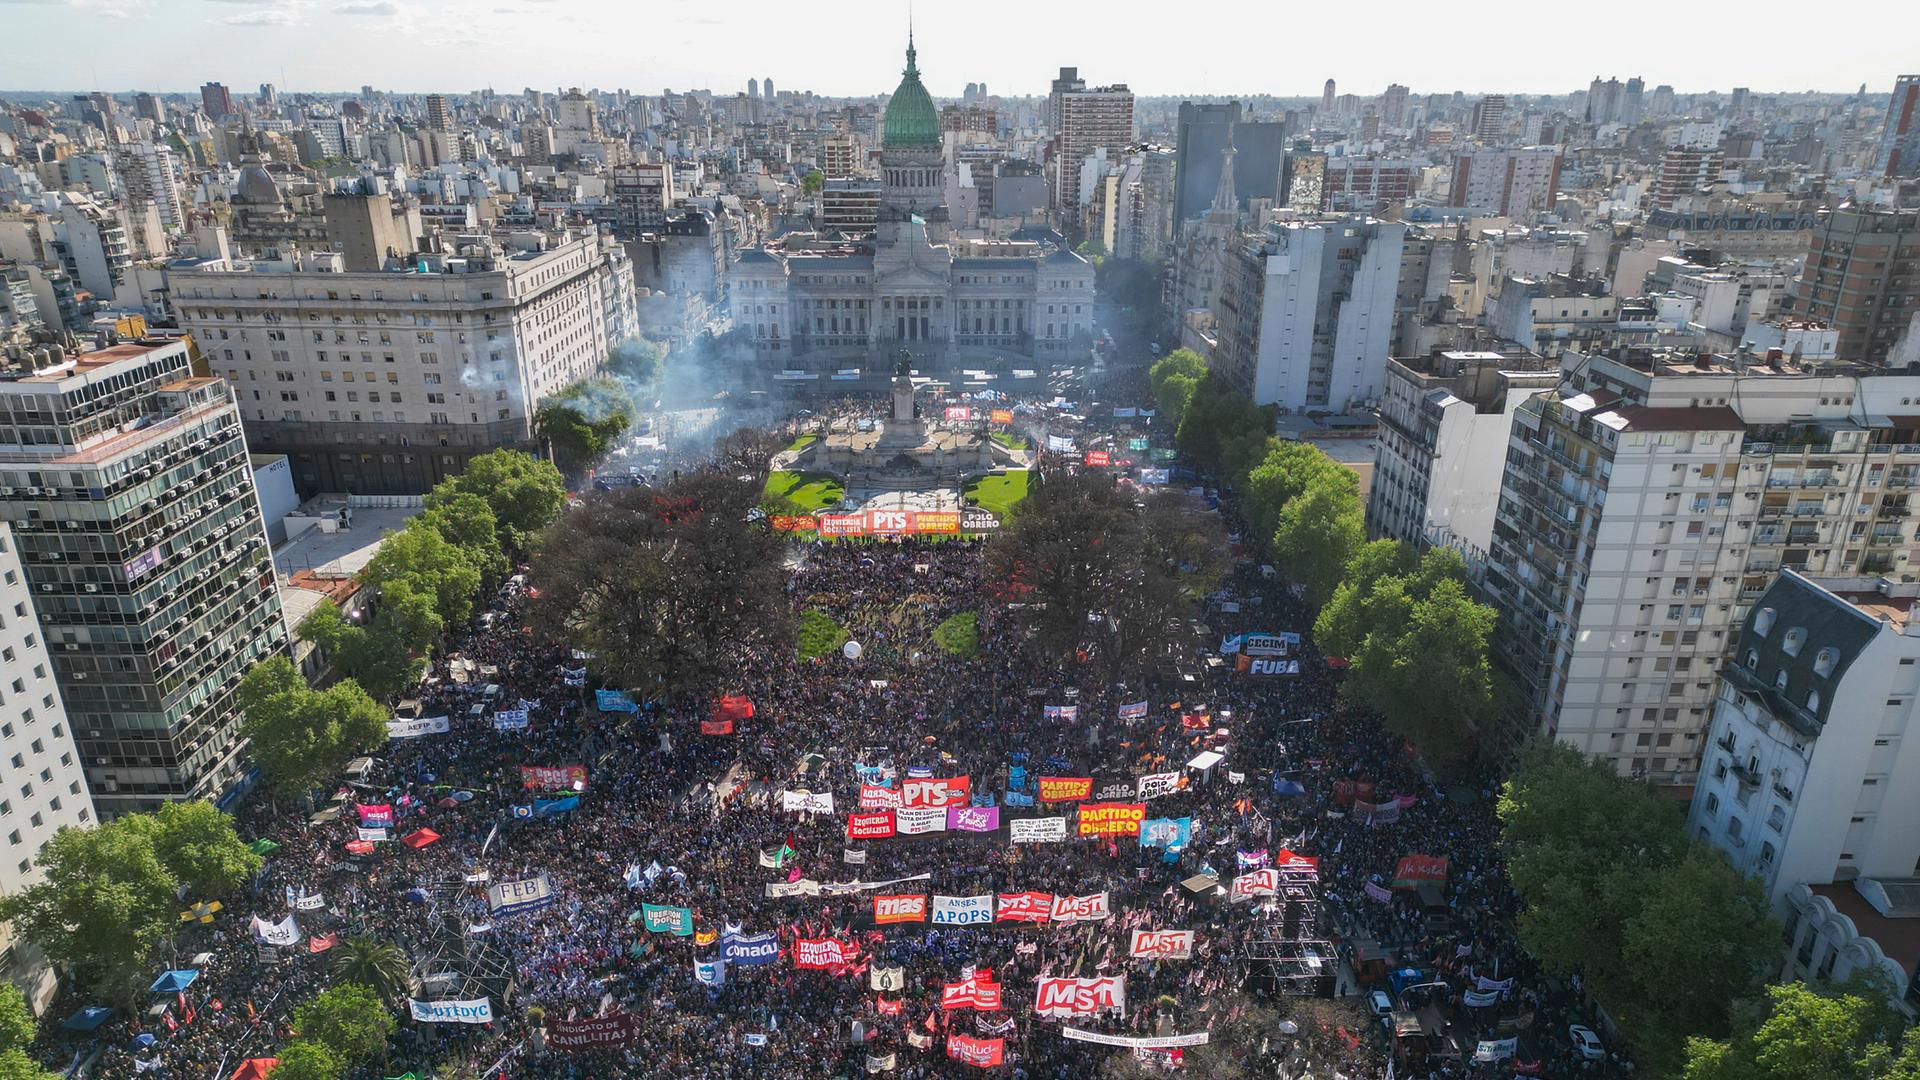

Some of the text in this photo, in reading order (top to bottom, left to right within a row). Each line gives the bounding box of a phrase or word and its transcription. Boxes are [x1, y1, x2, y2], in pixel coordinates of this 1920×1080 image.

[269, 460, 286, 472] HOTEL
[873, 511, 907, 529] PTS
[916, 514, 957, 523] PARTIDO
[962, 519, 1000, 529] OBRERO
[968, 513, 993, 522] POLO
[918, 522, 956, 531] OBRERO
[1248, 638, 1286, 648] CECIM
[1250, 660, 1300, 674] FUBA
[1041, 781, 1089, 790] PARTIDO
[1102, 784, 1129, 792] POLO
[903, 781, 948, 805] PTS
[1042, 788, 1087, 799] OBRERO
[1095, 789, 1135, 800] OBRERO
[854, 816, 889, 826] IZQUIERDA
[1080, 808, 1143, 821] PARTIDO
[853, 826, 890, 835] SOCIALISTA
[1080, 820, 1138, 833] OBRERO
[501, 880, 537, 899] FEB
[880, 897, 924, 914] mas
[948, 899, 977, 907] ANSES
[1060, 897, 1102, 916] MST
[935, 910, 990, 923] APOPS
[1138, 933, 1186, 952] MST
[726, 942, 778, 957] conadu
[945, 980, 976, 998] PTS
[1044, 981, 1115, 1011] MST
[433, 1004, 489, 1017] UTEDYC
[557, 1021, 620, 1033] SINDICATO DE
[552, 1028, 626, 1045] CANILLITAS
